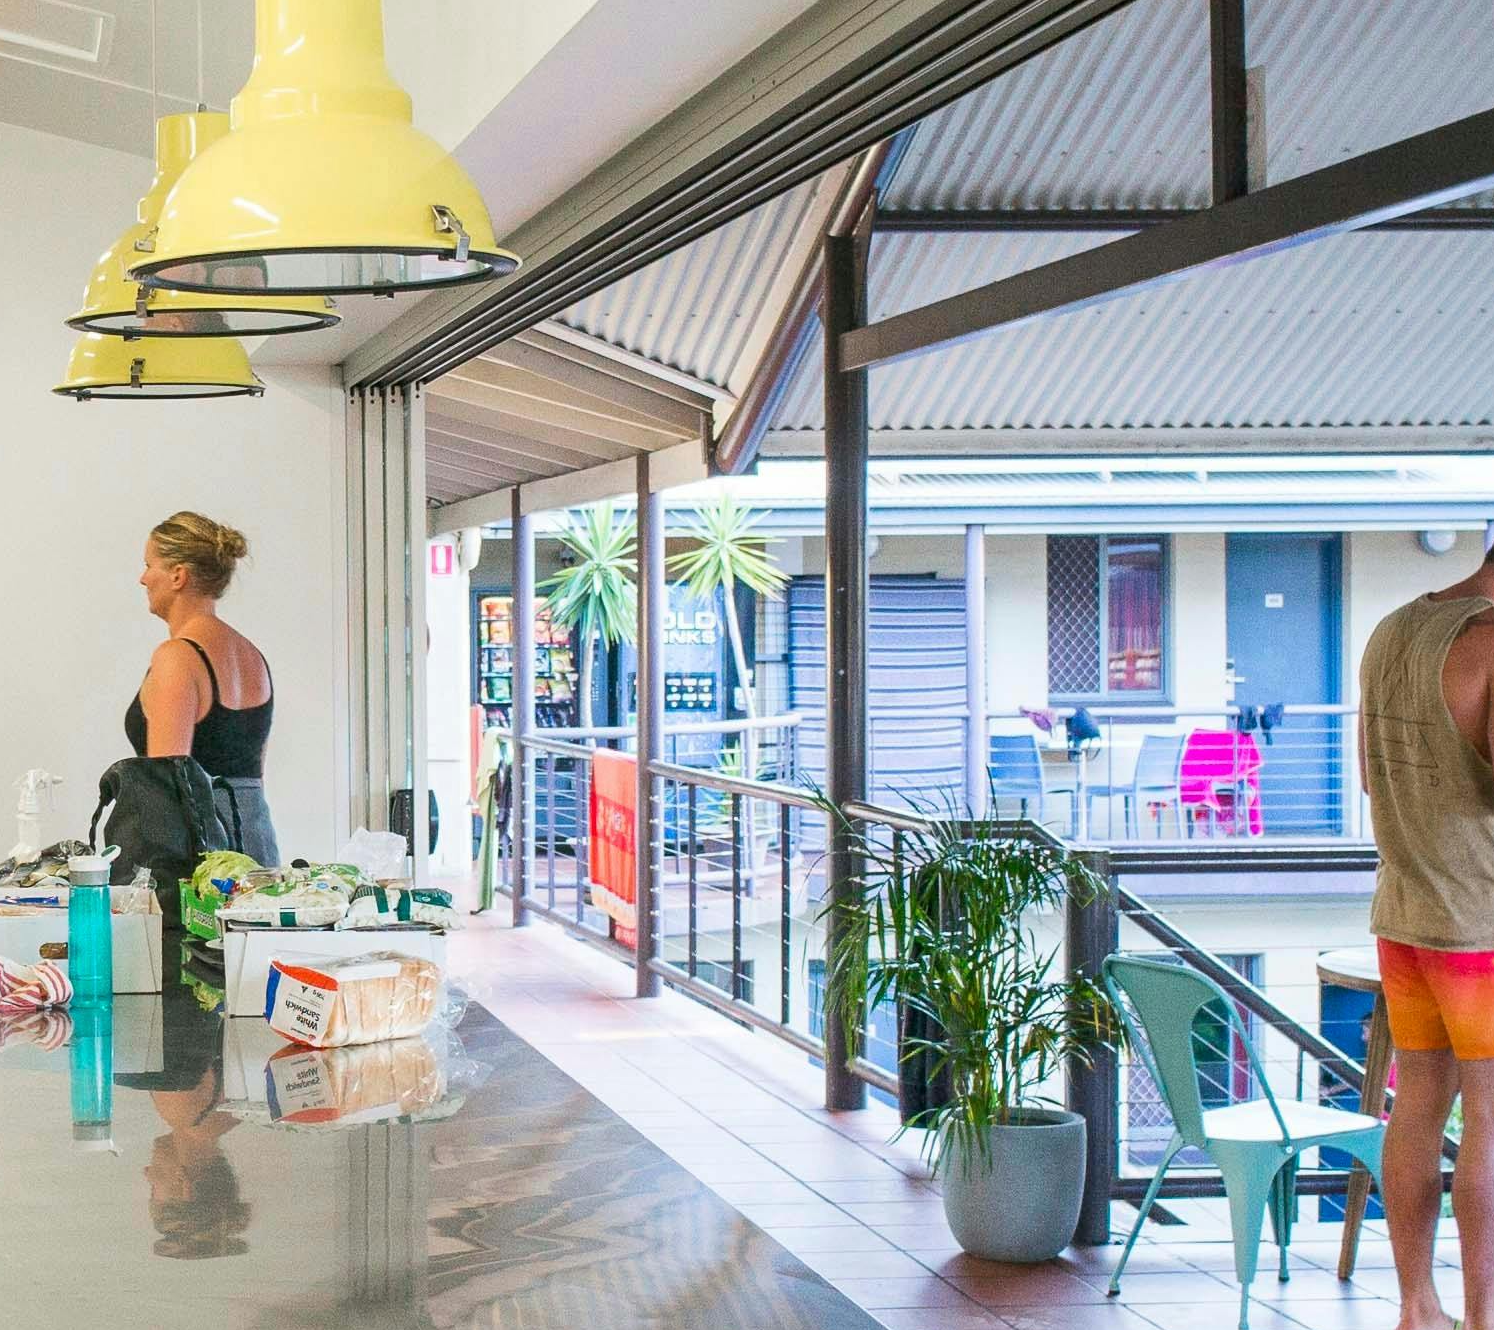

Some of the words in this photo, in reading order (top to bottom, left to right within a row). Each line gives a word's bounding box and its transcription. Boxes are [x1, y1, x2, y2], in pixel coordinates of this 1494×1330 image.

[663, 611, 717, 629] OLD
[663, 630, 717, 645] INKS
[285, 999, 321, 1021] Sandwich
[296, 1014, 319, 1031] White
